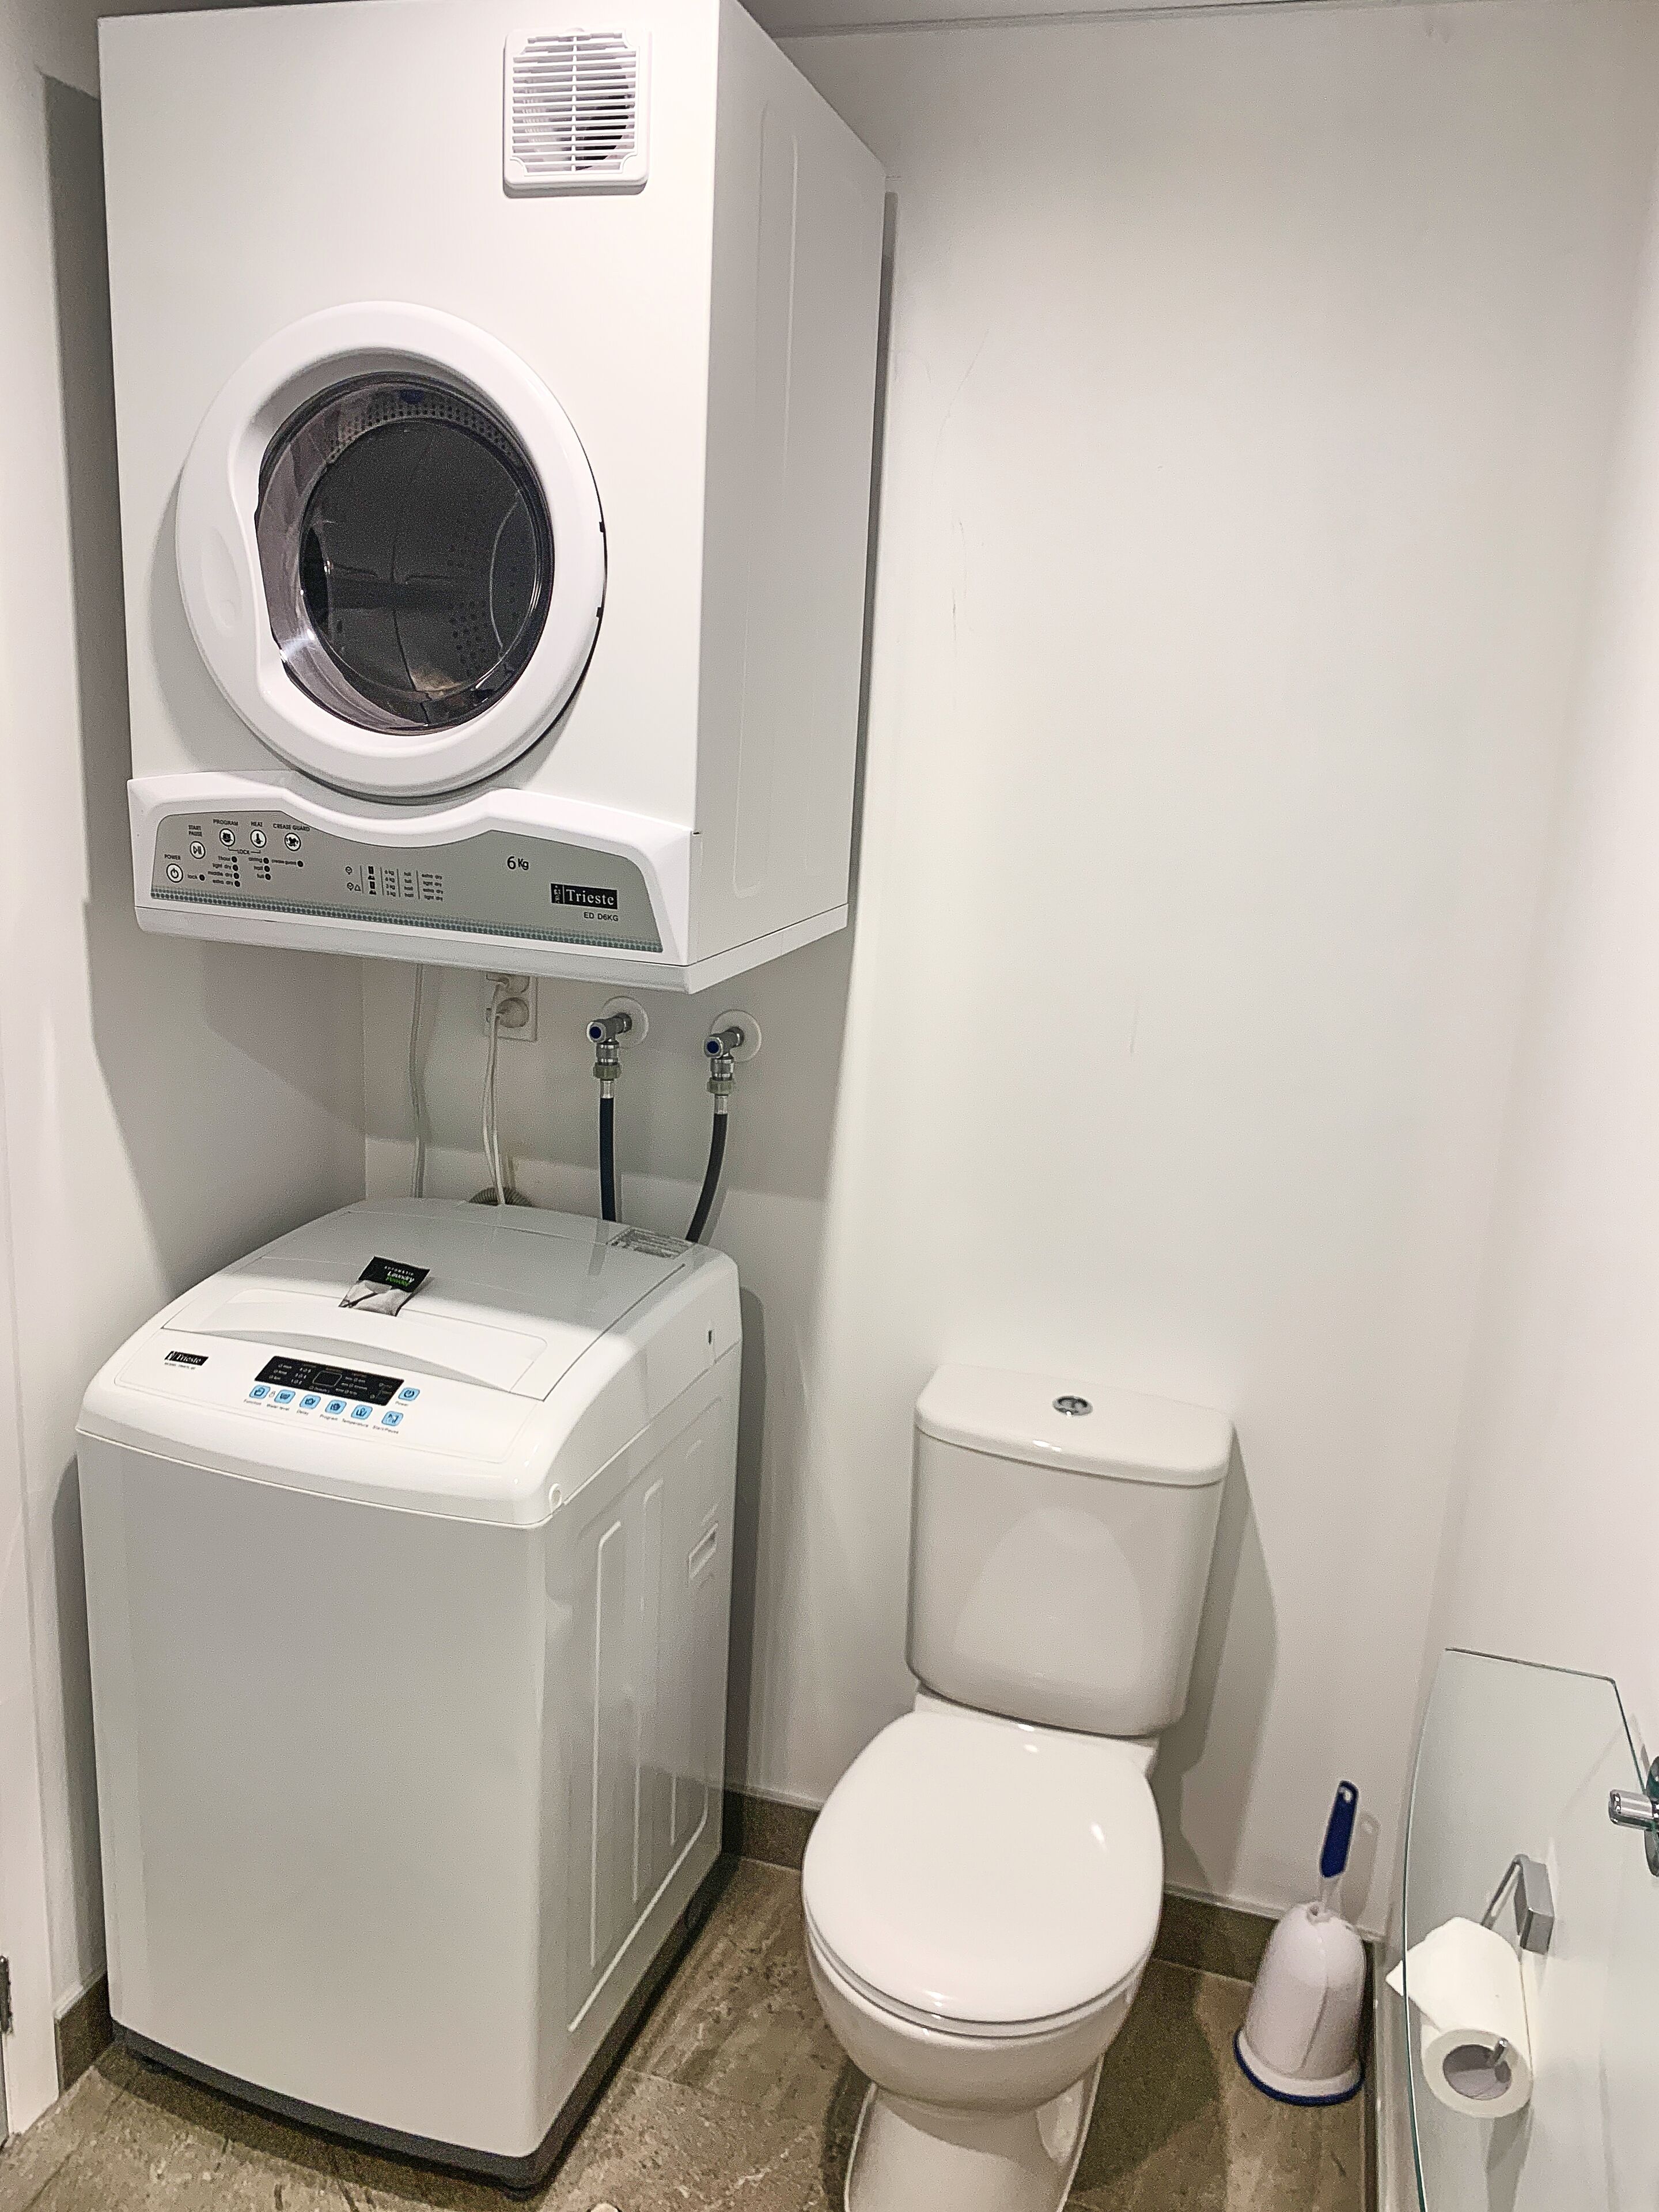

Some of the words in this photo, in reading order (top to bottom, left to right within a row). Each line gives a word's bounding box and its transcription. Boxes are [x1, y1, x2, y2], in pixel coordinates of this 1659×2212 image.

[566, 889, 614, 906] Trieste
[597, 913, 619, 922] D6KG
[176, 1354, 201, 1363] Trieste
